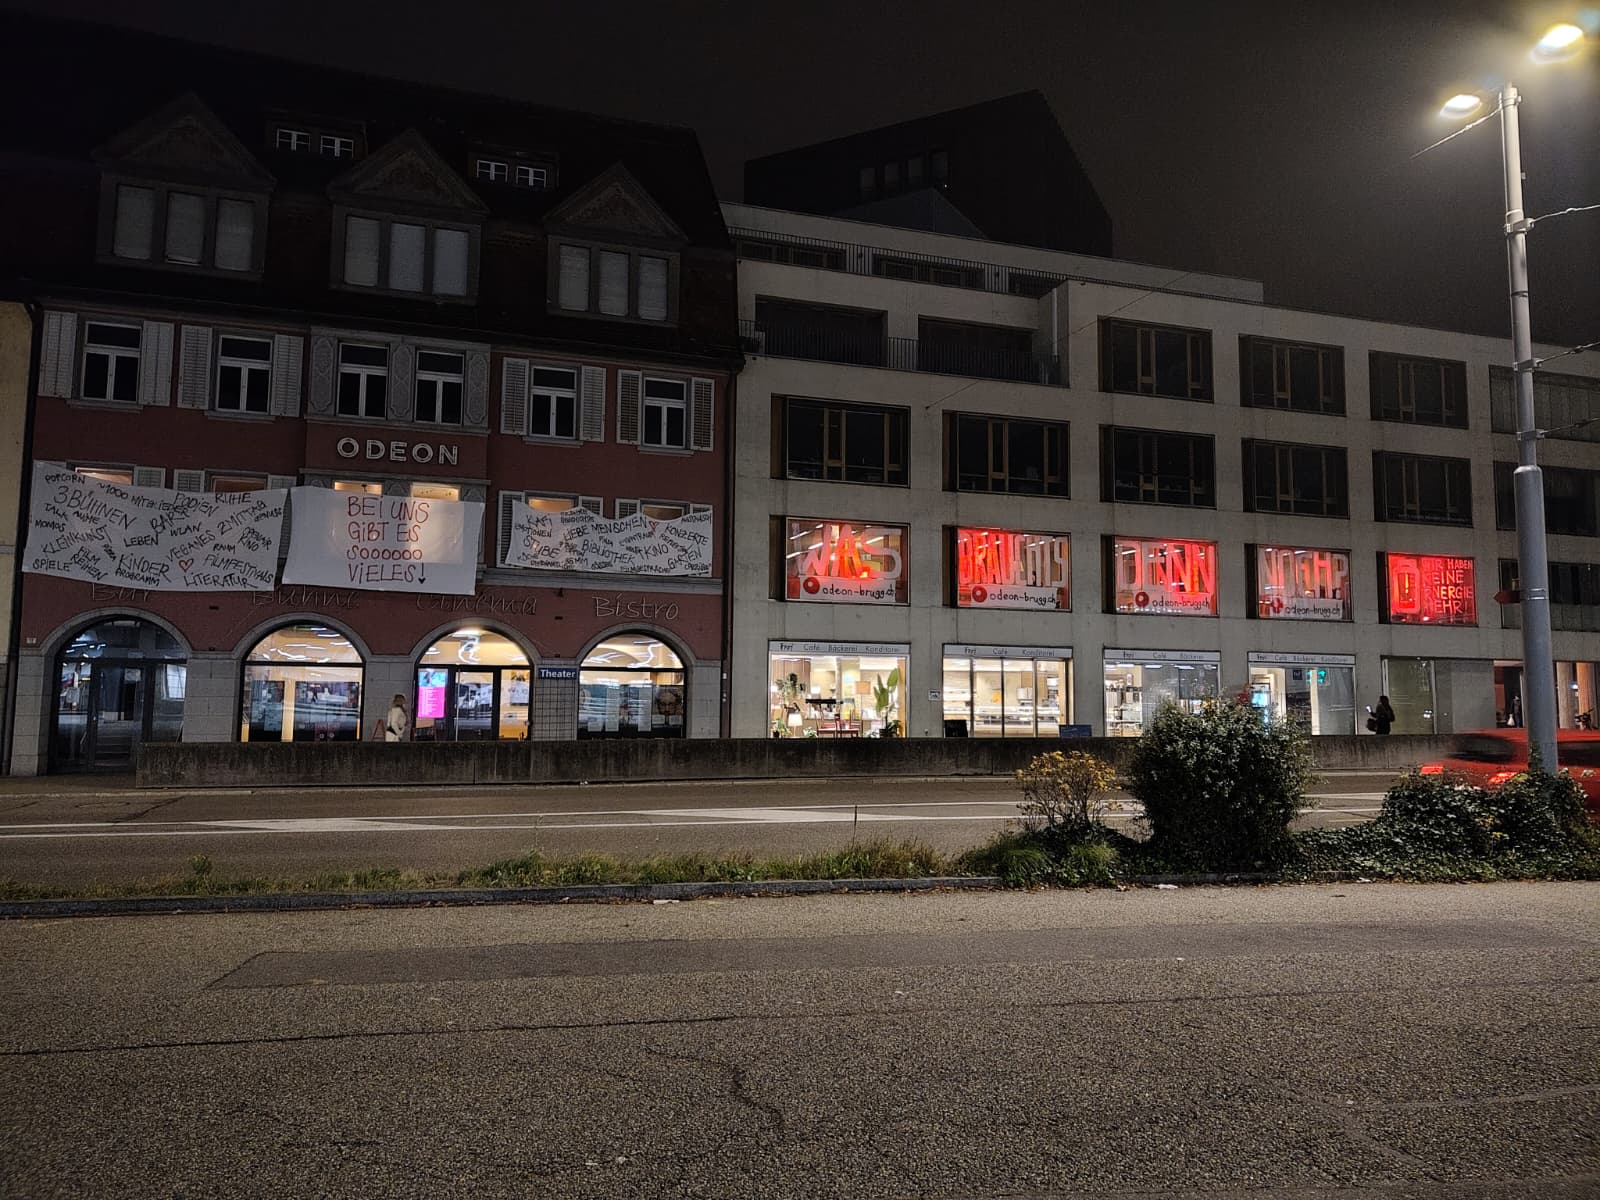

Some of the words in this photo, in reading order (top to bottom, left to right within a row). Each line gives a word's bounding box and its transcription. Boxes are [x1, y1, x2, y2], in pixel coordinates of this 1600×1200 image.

[337, 437, 458, 465] ODEON
[45, 473, 86, 485] POPCORN
[216, 492, 251, 505] RUHE
[347, 495, 384, 519] BEI
[391, 500, 430, 524] UNS
[348, 520, 389, 544] GIBT
[397, 523, 421, 543] ES
[591, 515, 648, 535] MENSCHEN
[123, 534, 158, 548] LEBEN
[33, 558, 73, 571] SPIELE
[118, 551, 173, 583] KINDER
[183, 571, 259, 589] LITERATUR
[592, 592, 679, 620] Bistro
[540, 669, 576, 679] Theater
